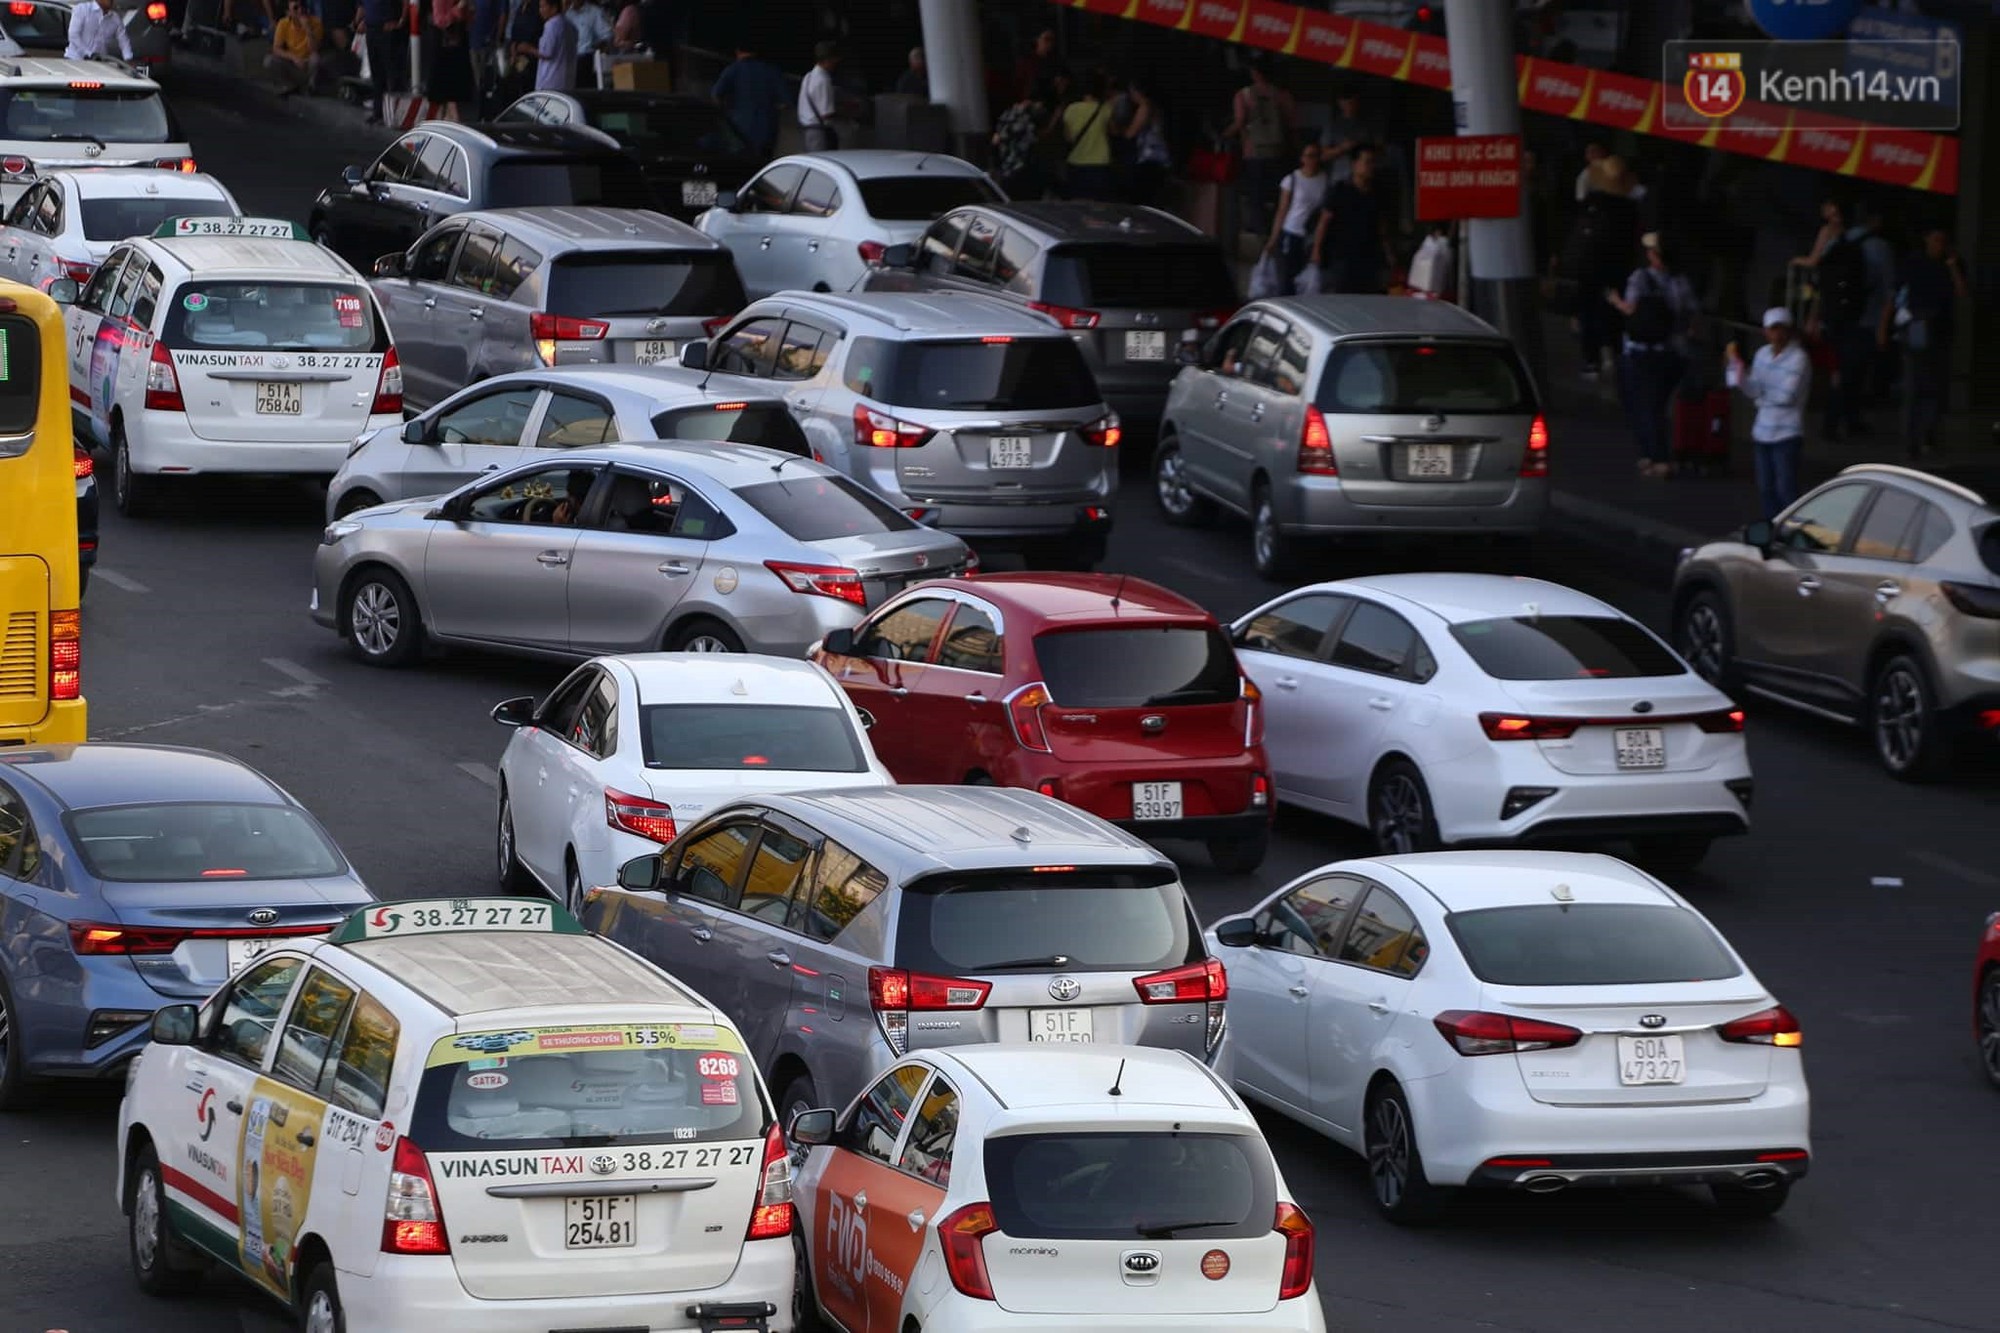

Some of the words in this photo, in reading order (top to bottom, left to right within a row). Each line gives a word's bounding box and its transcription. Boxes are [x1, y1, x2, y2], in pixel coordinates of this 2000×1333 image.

[202, 222, 245, 235] 38.27
[249, 224, 267, 236] 27
[271, 225, 291, 238] 27
[645, 341, 667, 355] 48A
[297, 355, 340, 368] 38.27
[344, 356, 361, 369] 27
[365, 357, 382, 369] 27
[267, 384, 290, 399] 51A
[1143, 784, 1170, 801] 51F
[412, 909, 479, 927] 38.27
[485, 908, 513, 926] 27
[519, 907, 547, 924] 27
[1045, 1012, 1078, 1032] 51F
[625, 1030, 677, 1045] 15.5%
[1634, 1039, 1668, 1060] 60A
[699, 1057, 738, 1076] 8268
[472, 1075, 503, 1086] SATRA
[673, 1126, 697, 1140] (028)
[622, 1149, 689, 1172] 38.27
[695, 1147, 722, 1168] 27
[729, 1146, 755, 1166] 27
[582, 1198, 617, 1221] 51F
[569, 1220, 631, 1246] 254.81
[827, 1189, 867, 1284] FWD
[1009, 1246, 1059, 1258] morning
[1130, 1257, 1156, 1269] KIA
